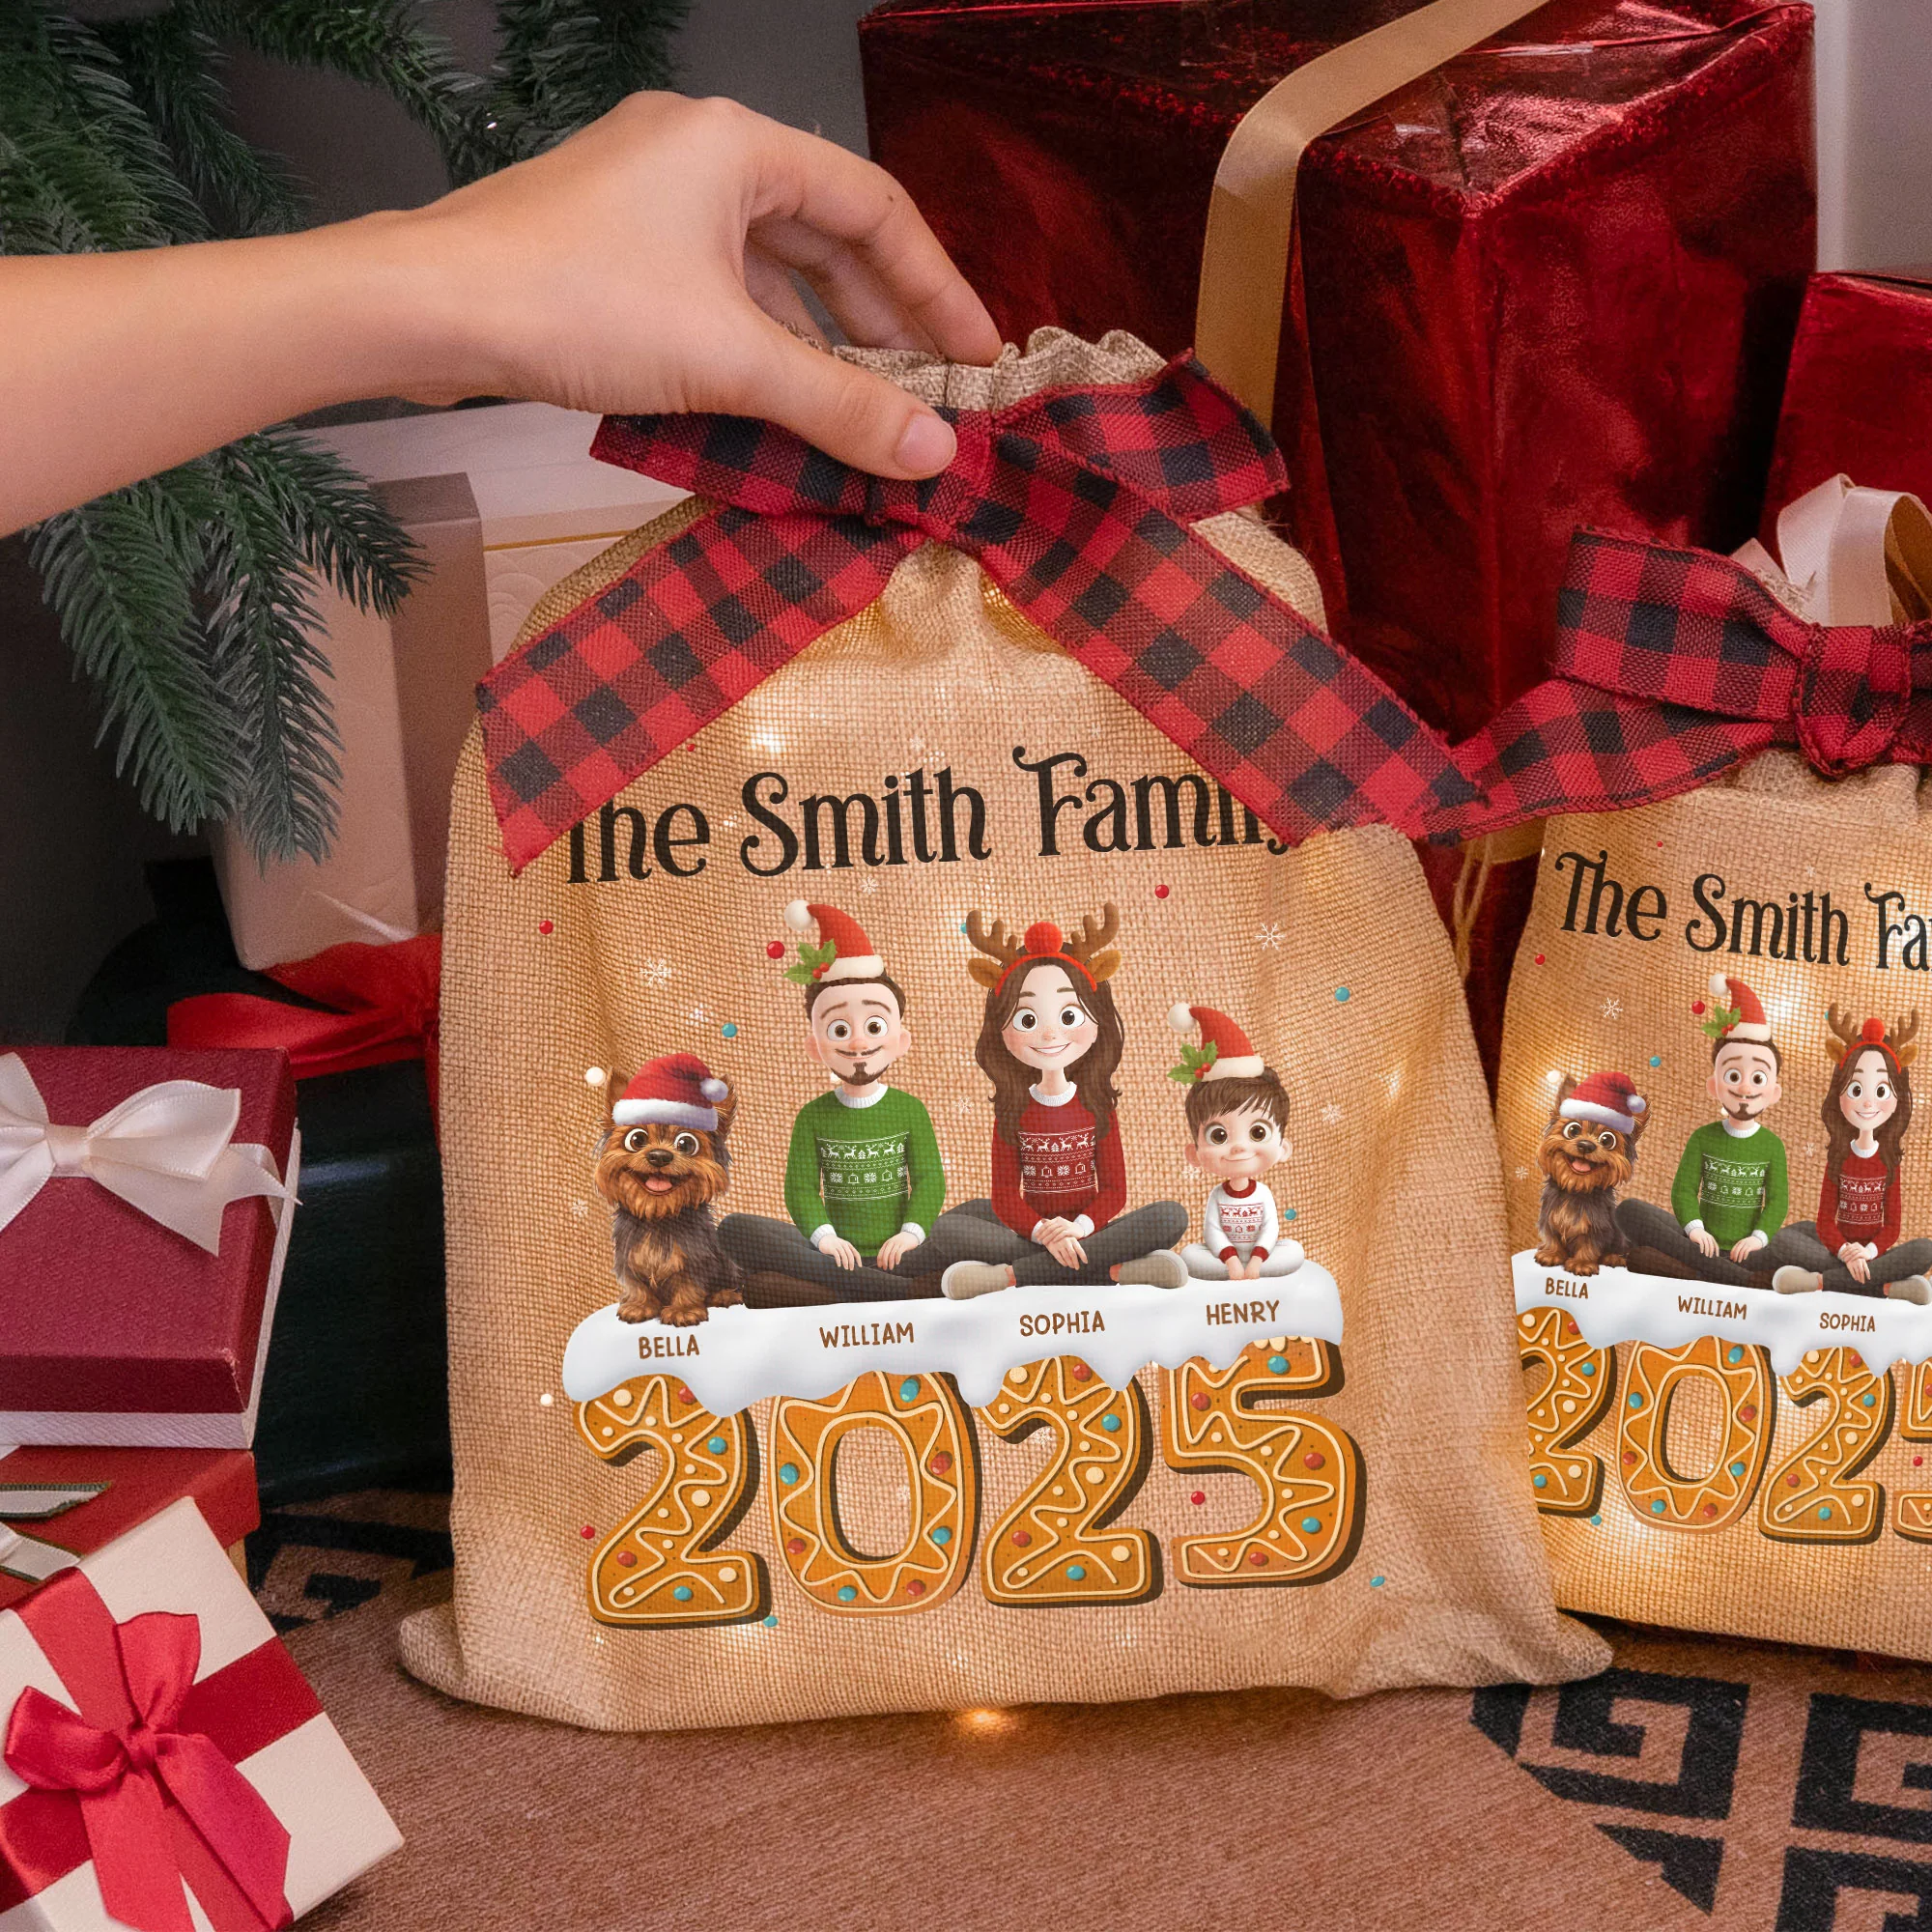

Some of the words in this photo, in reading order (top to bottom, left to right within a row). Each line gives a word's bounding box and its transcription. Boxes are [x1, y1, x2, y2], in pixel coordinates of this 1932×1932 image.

[740, 766, 992, 877] Smith
[1012, 745, 1290, 856] Fami
[1554, 849, 1667, 942] The
[1685, 873, 1851, 967] Smith
[638, 1333, 700, 1360] BELLA
[818, 1321, 916, 1349] WILLIAM
[1019, 1309, 1106, 1338] SOPHIA
[1206, 1299, 1281, 1326] HENRY
[1545, 1276, 1589, 1300] BELLA
[1677, 1294, 1747, 1321] WILLIAM
[1818, 1312, 1876, 1333] SOPHIA
[579, 1336, 1366, 1630] 2025
[1518, 1306, 1932, 1546] 202
